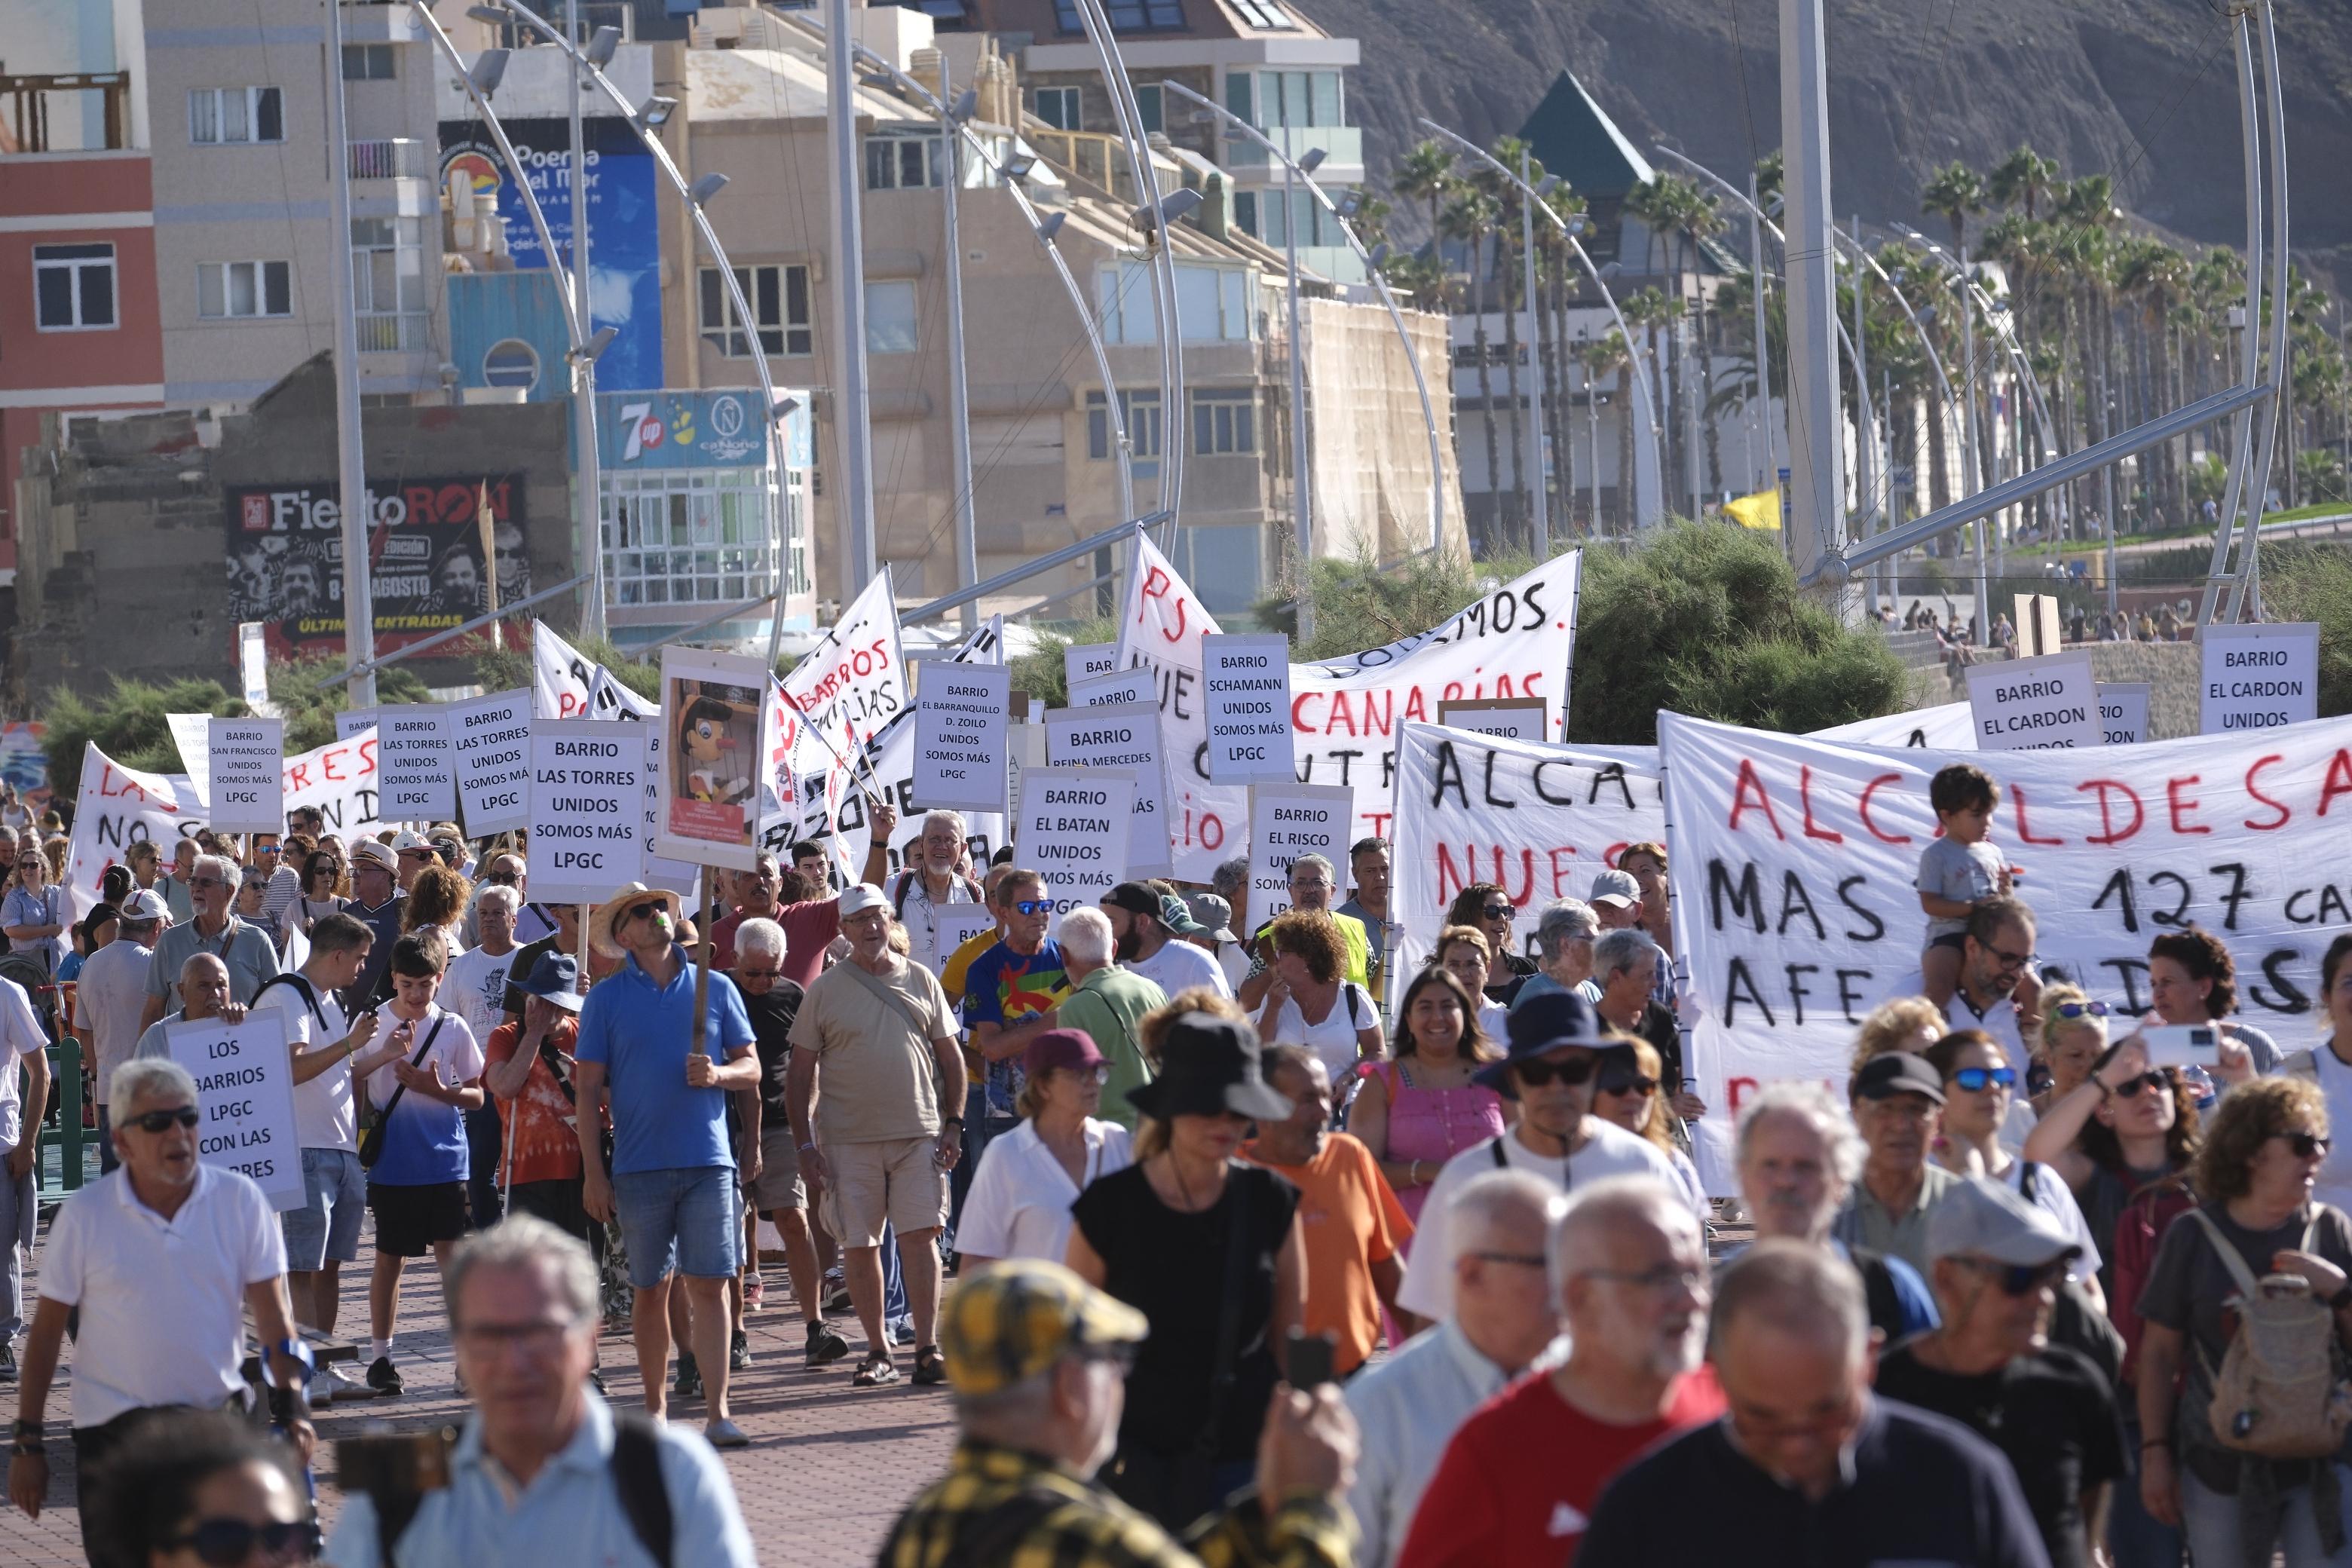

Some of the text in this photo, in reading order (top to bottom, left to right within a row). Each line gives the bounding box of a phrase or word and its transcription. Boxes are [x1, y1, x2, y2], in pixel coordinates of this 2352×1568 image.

[270, 484, 512, 531] FietoRON
[384, 539, 426, 555] EDICIÓN
[371, 575, 430, 599] AGOSTO
[299, 615, 464, 634] ÚLTIM ENTRADAS
[1221, 656, 1268, 669] BARRIO
[2226, 651, 2287, 667] BARRIO
[948, 685, 989, 698] BARRIO
[1209, 678, 1282, 692] SCHAMANN
[1996, 679, 2063, 703] BARRIO
[2210, 681, 2302, 698] EL CARDON
[1089, 689, 1136, 707] BARRIO
[922, 701, 1000, 715] EL BARRANQUILLO
[1223, 702, 1272, 715] UNIDOS
[2099, 706, 2123, 718] RIO
[465, 709, 513, 727] BARRIO
[945, 718, 987, 728] D. ZOILO
[1983, 707, 2086, 735] EL CARDON
[2223, 712, 2289, 728] UNIDOS
[394, 721, 436, 732] BARRIO
[1214, 721, 1285, 736] SOMOS MÁS
[226, 732, 262, 741] BARRIO
[384, 739, 448, 750] LAS TORRES
[455, 726, 529, 750] LAS TORRES
[939, 733, 979, 745] UNIDOS
[1070, 728, 1132, 747] BARRIO
[231, 747, 277, 755] FRANCISCO
[555, 742, 618, 758] BARRIO
[926, 750, 991, 764] SOMOS MÁS
[1229, 747, 1266, 761] LPGC
[228, 761, 262, 770] UNIDOS
[394, 757, 437, 768] UNIDOS
[472, 749, 522, 769] UNIDOS
[1092, 752, 1152, 767] MERCEDES
[217, 774, 272, 784] SOMOS MÁS
[384, 773, 448, 785] SOMOS MÁS
[464, 767, 529, 791] SOMOS MÁ
[537, 770, 635, 786] LAS TORRES
[940, 769, 966, 779] LPGC
[226, 792, 258, 803] LPGC
[397, 792, 429, 804] LPGC
[482, 792, 519, 811] LPGC
[553, 798, 618, 813] UNIDOS
[1045, 790, 1107, 806] BARRIO
[1729, 749, 2352, 846] ALCLDESA
[1274, 808, 1329, 823] BARRIO
[536, 823, 632, 840] SOMOS MÁS
[1035, 817, 1110, 833] EL BATAN
[1269, 832, 1330, 847] EL RISCO
[1037, 844, 1101, 860] UNIDOS
[554, 852, 603, 869] LPGC
[1040, 870, 1113, 886] MOS MÁS
[1254, 877, 1286, 890] SOM
[1708, 858, 1885, 942] MAS
[2091, 862, 2254, 933] 127
[209, 1040, 240, 1059] LOS
[210, 1100, 253, 1122] LPGC
[199, 1128, 271, 1155] CON LAS
